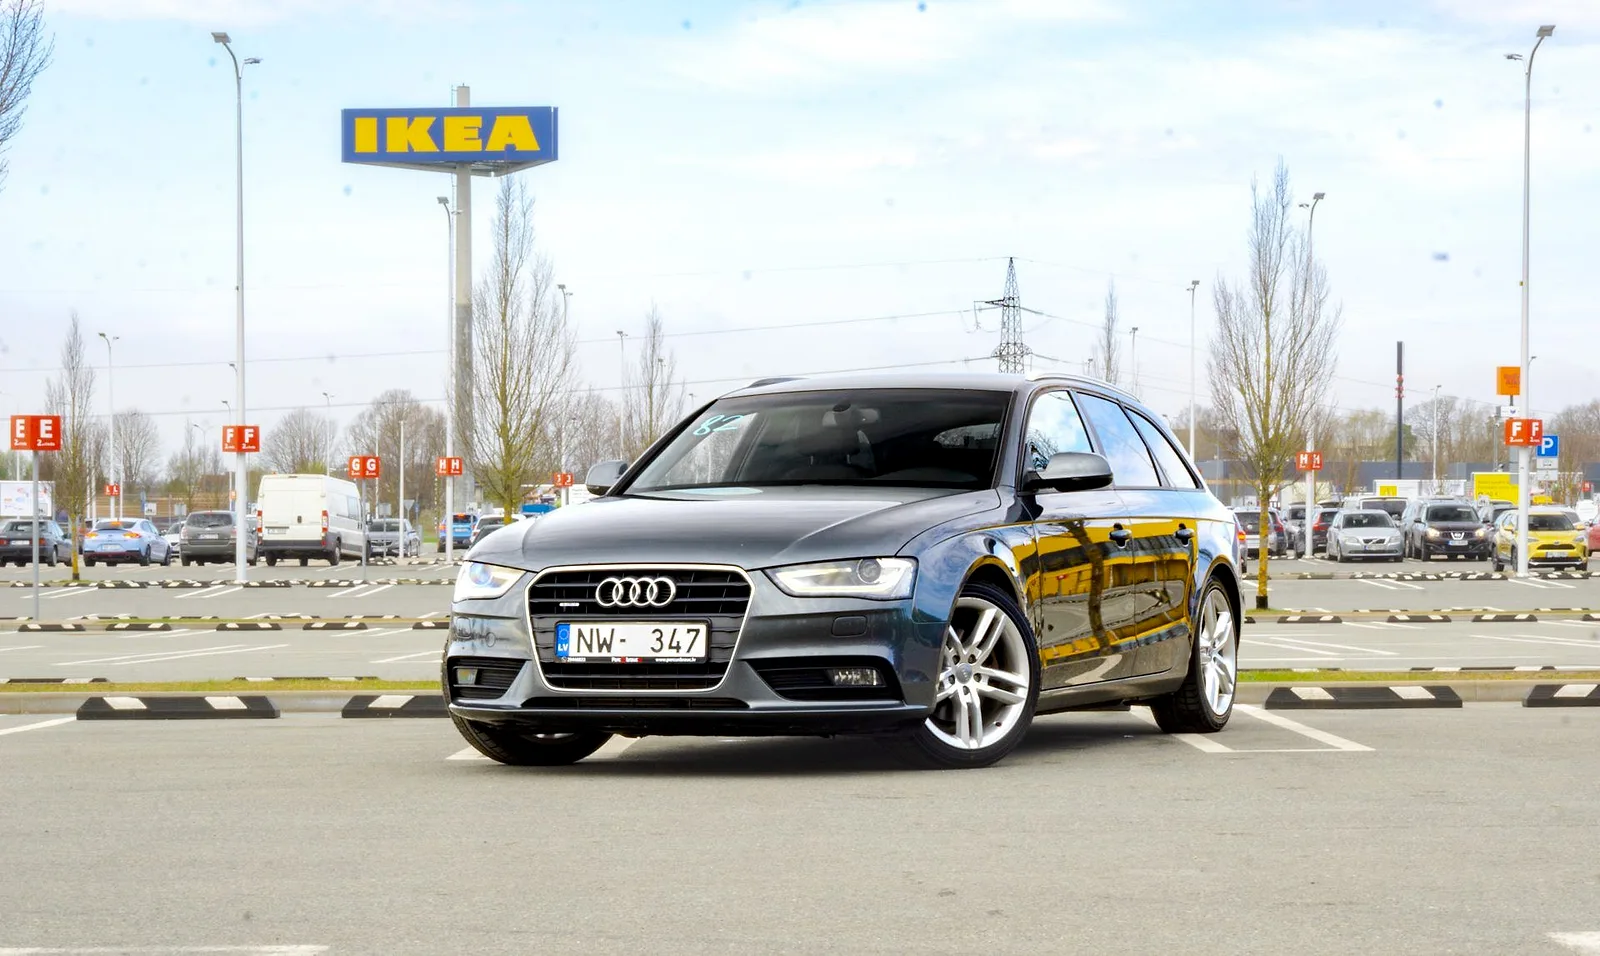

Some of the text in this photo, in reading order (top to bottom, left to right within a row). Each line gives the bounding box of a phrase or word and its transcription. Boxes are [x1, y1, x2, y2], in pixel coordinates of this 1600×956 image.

[354, 115, 541, 153] IKEA
[15, 419, 26, 438] E
[40, 419, 53, 438] E
[226, 428, 235, 443] F
[244, 428, 255, 443] F
[1511, 421, 1523, 437] F
[1531, 421, 1540, 437] F
[1541, 437, 1554, 455] P
[352, 458, 361, 471] G
[366, 458, 377, 471] G
[439, 459, 446, 470] H
[451, 458, 460, 470] H
[557, 643, 569, 651] LV
[576, 627, 701, 653] NW- 347
